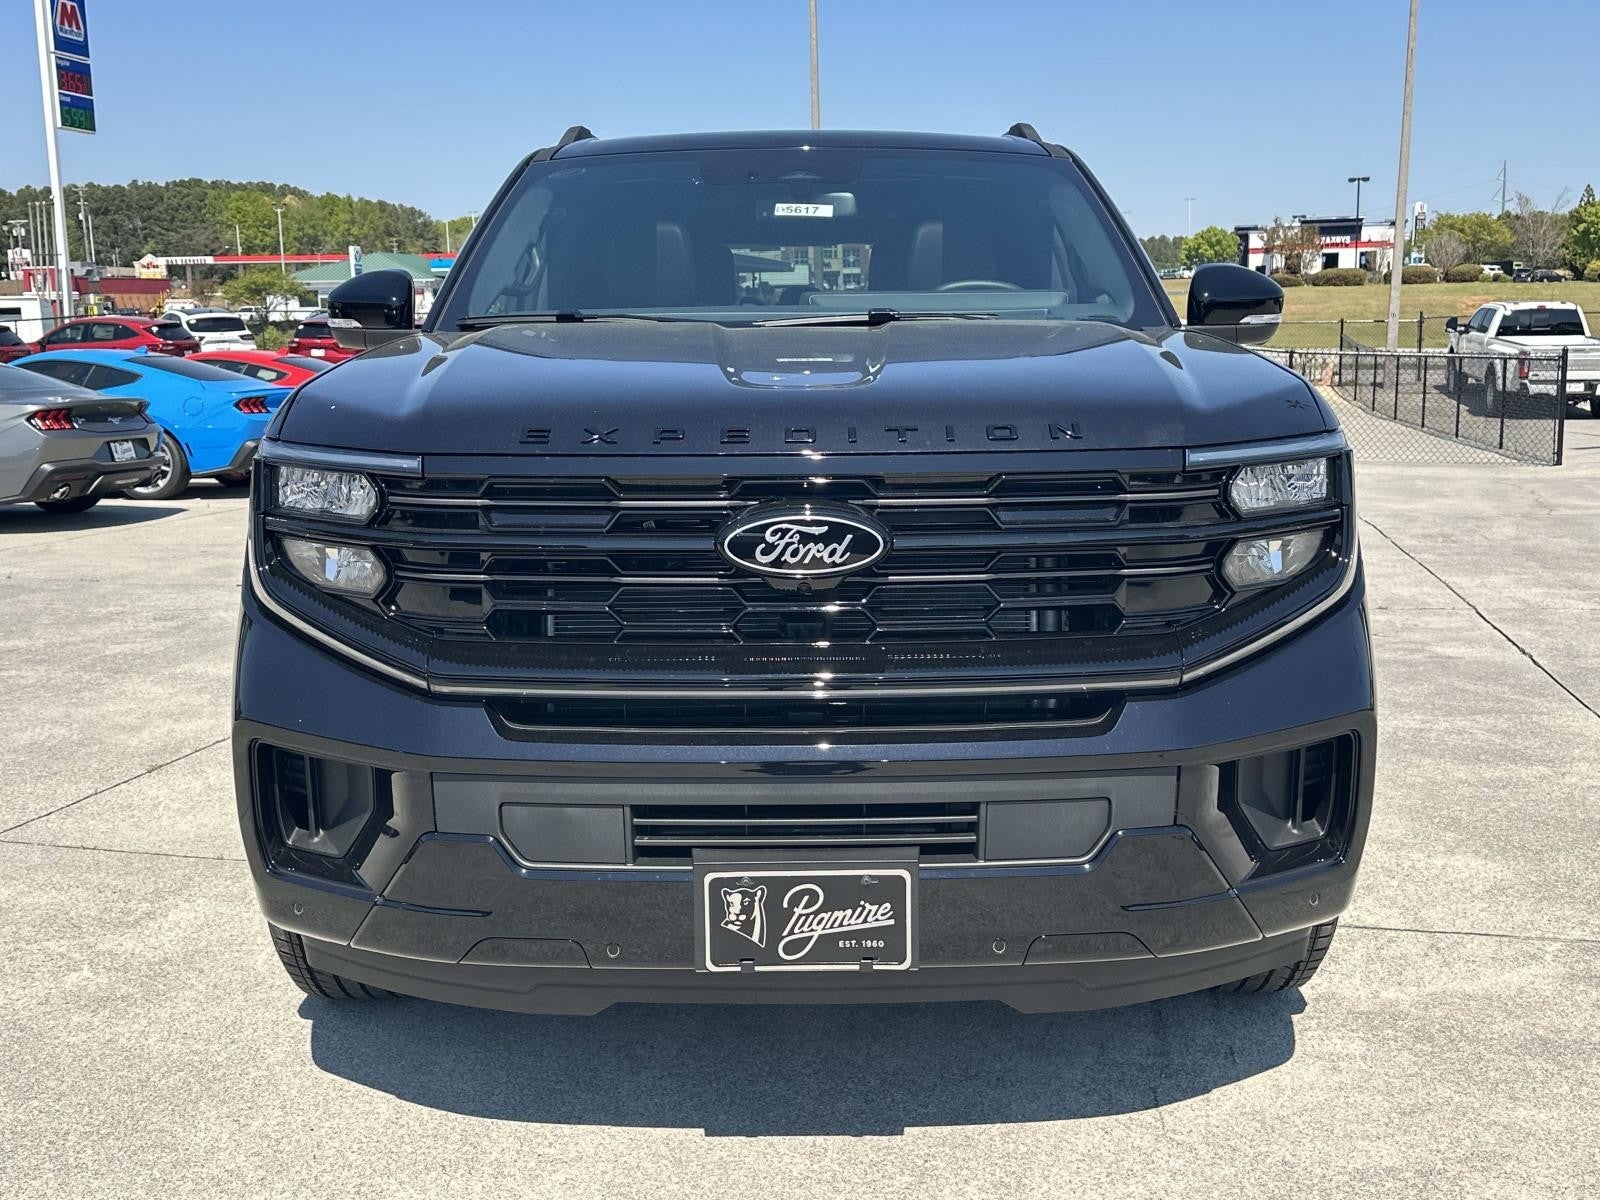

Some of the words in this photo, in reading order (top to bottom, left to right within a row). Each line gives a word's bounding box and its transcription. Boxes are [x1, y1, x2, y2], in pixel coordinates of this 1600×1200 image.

[519, 423, 1083, 444] EXPEDITION
[755, 523, 853, 567] Ford
[778, 883, 895, 960] Pugmire
[838, 940, 859, 948] EST.
[861, 940, 885, 948] 1960
